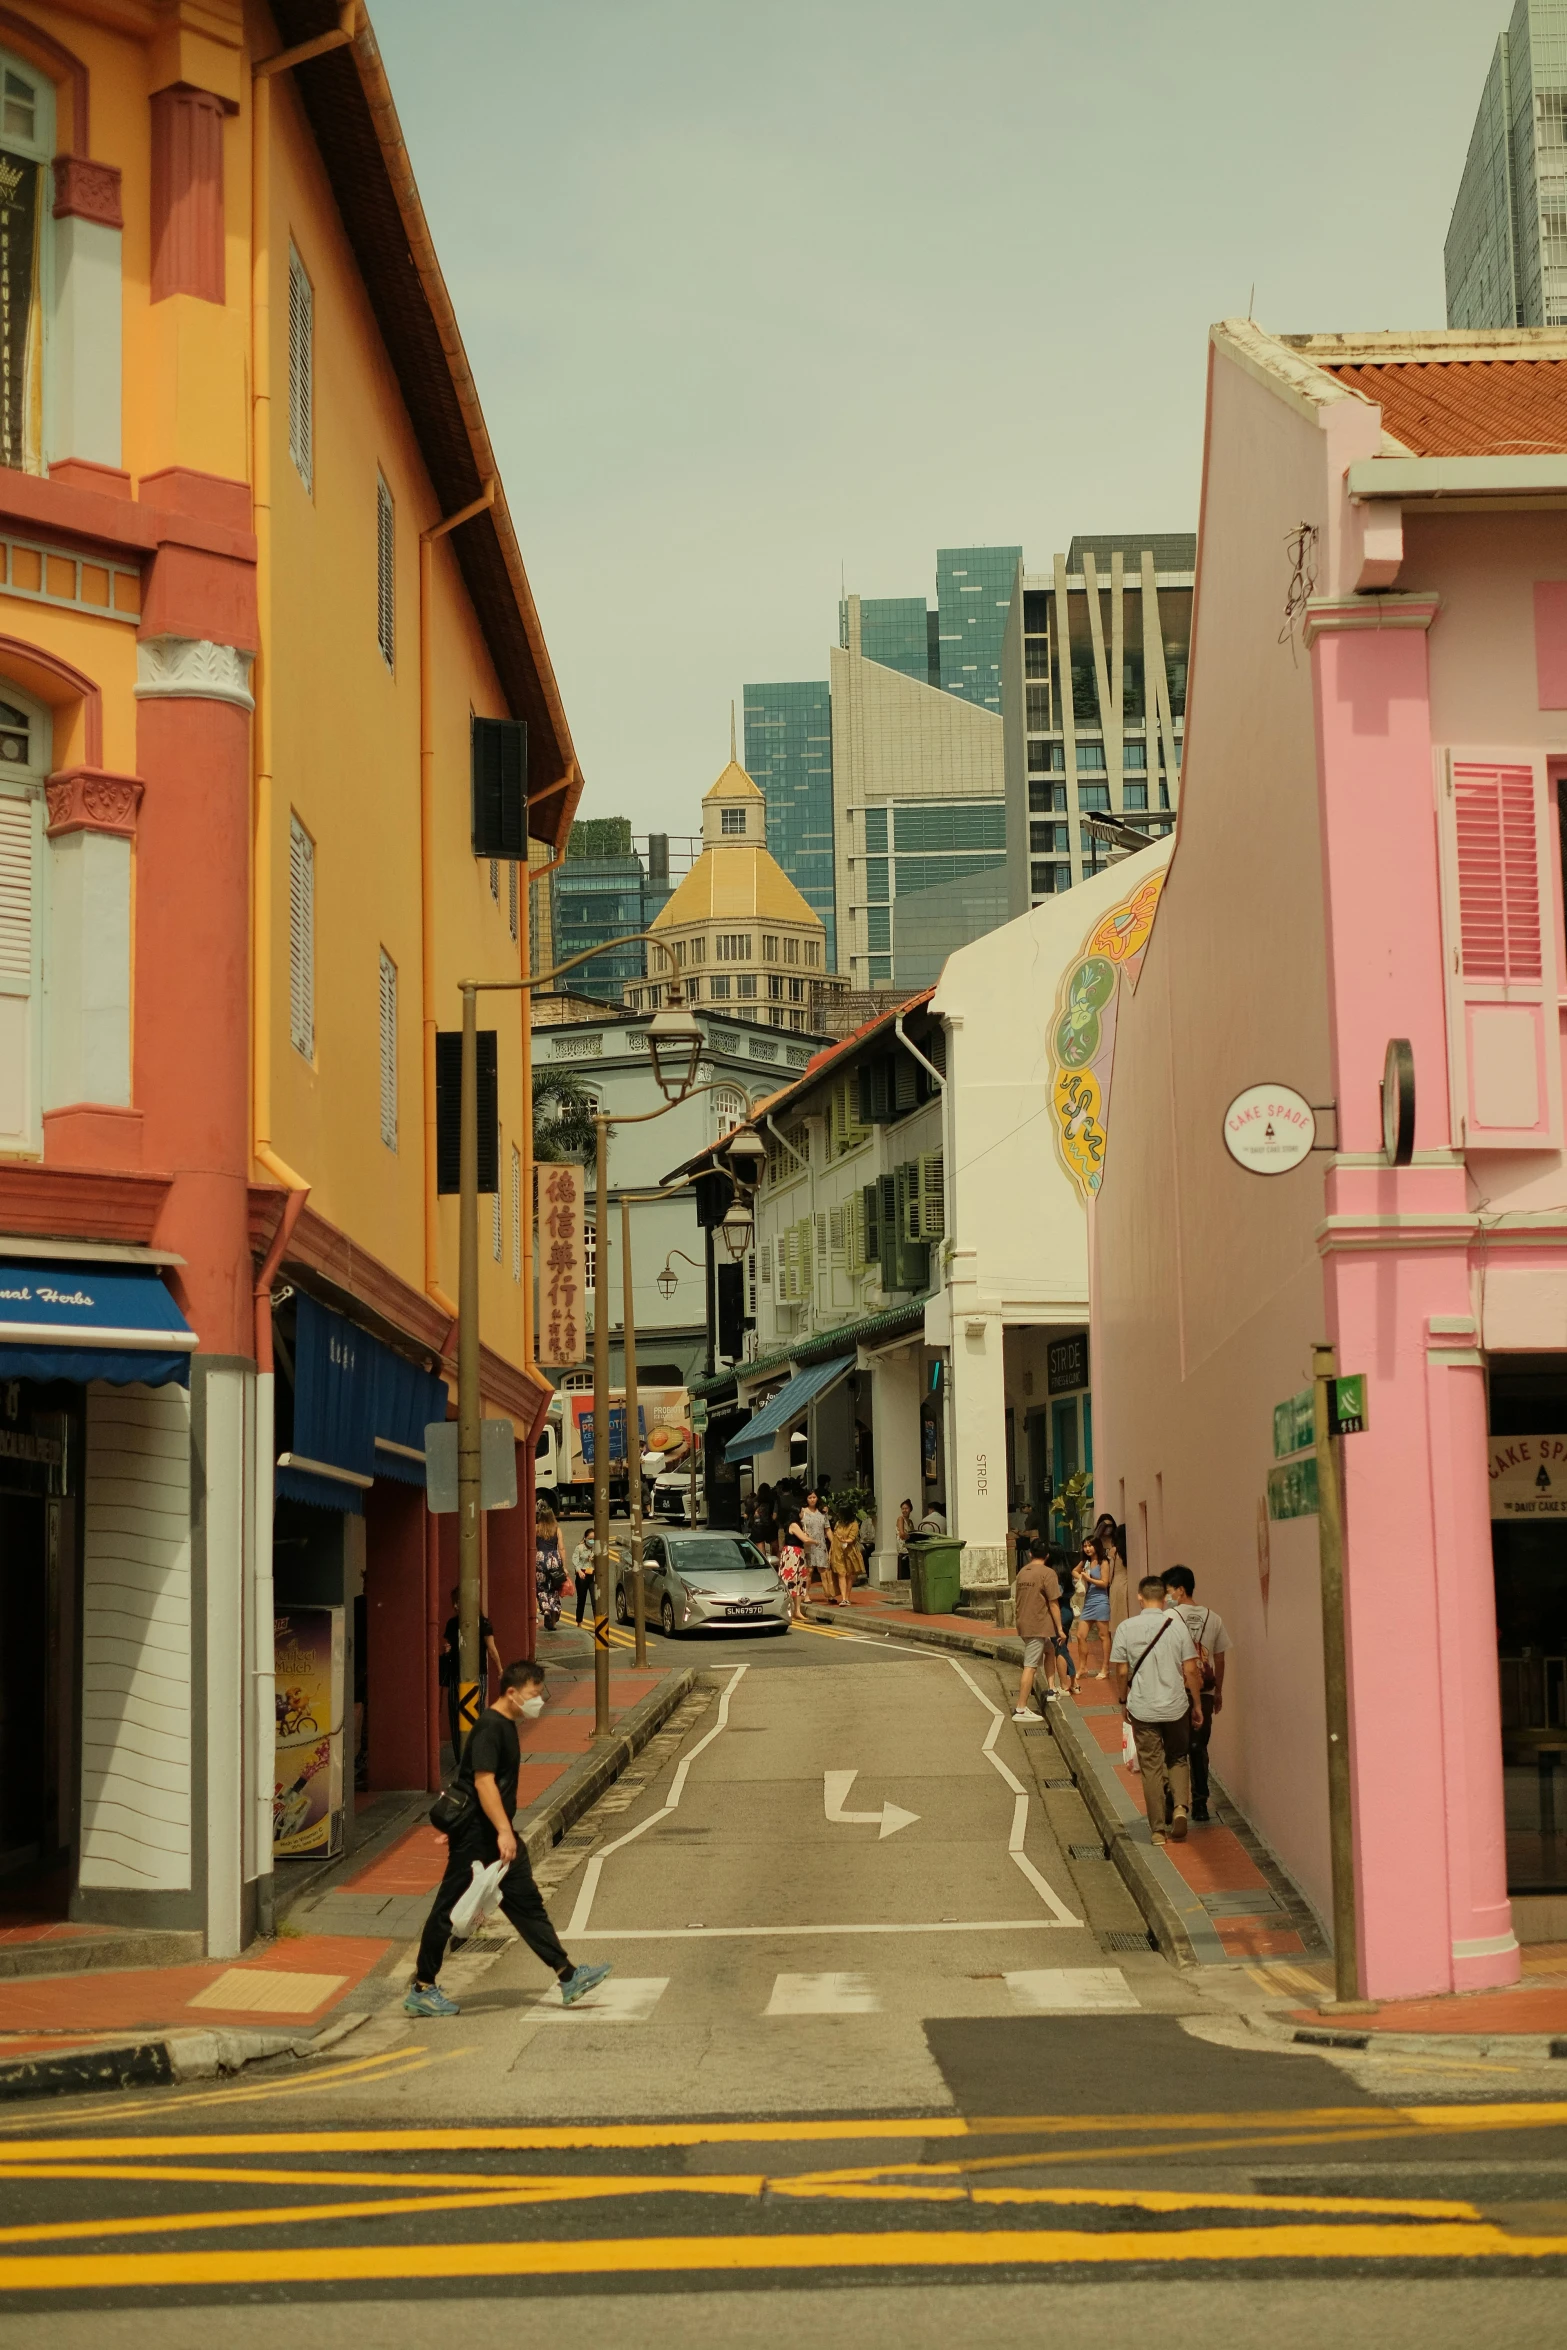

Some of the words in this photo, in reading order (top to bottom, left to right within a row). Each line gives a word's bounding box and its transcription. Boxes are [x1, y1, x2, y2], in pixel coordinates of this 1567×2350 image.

[1228, 1105, 1262, 1132] CAKE
[1267, 1104, 1310, 1129] SPADE
[36, 1288, 95, 1306] Herbs
[1488, 1442, 1531, 1479] CAKE
[634, 1479, 639, 1489] 3
[600, 1488, 607, 1500] 2
[468, 1502, 475, 1518] 1
[1515, 1502, 1536, 1512] DAILY
[1539, 1501, 1559, 1512] CAKE
[275, 1661, 312, 1674] Match
